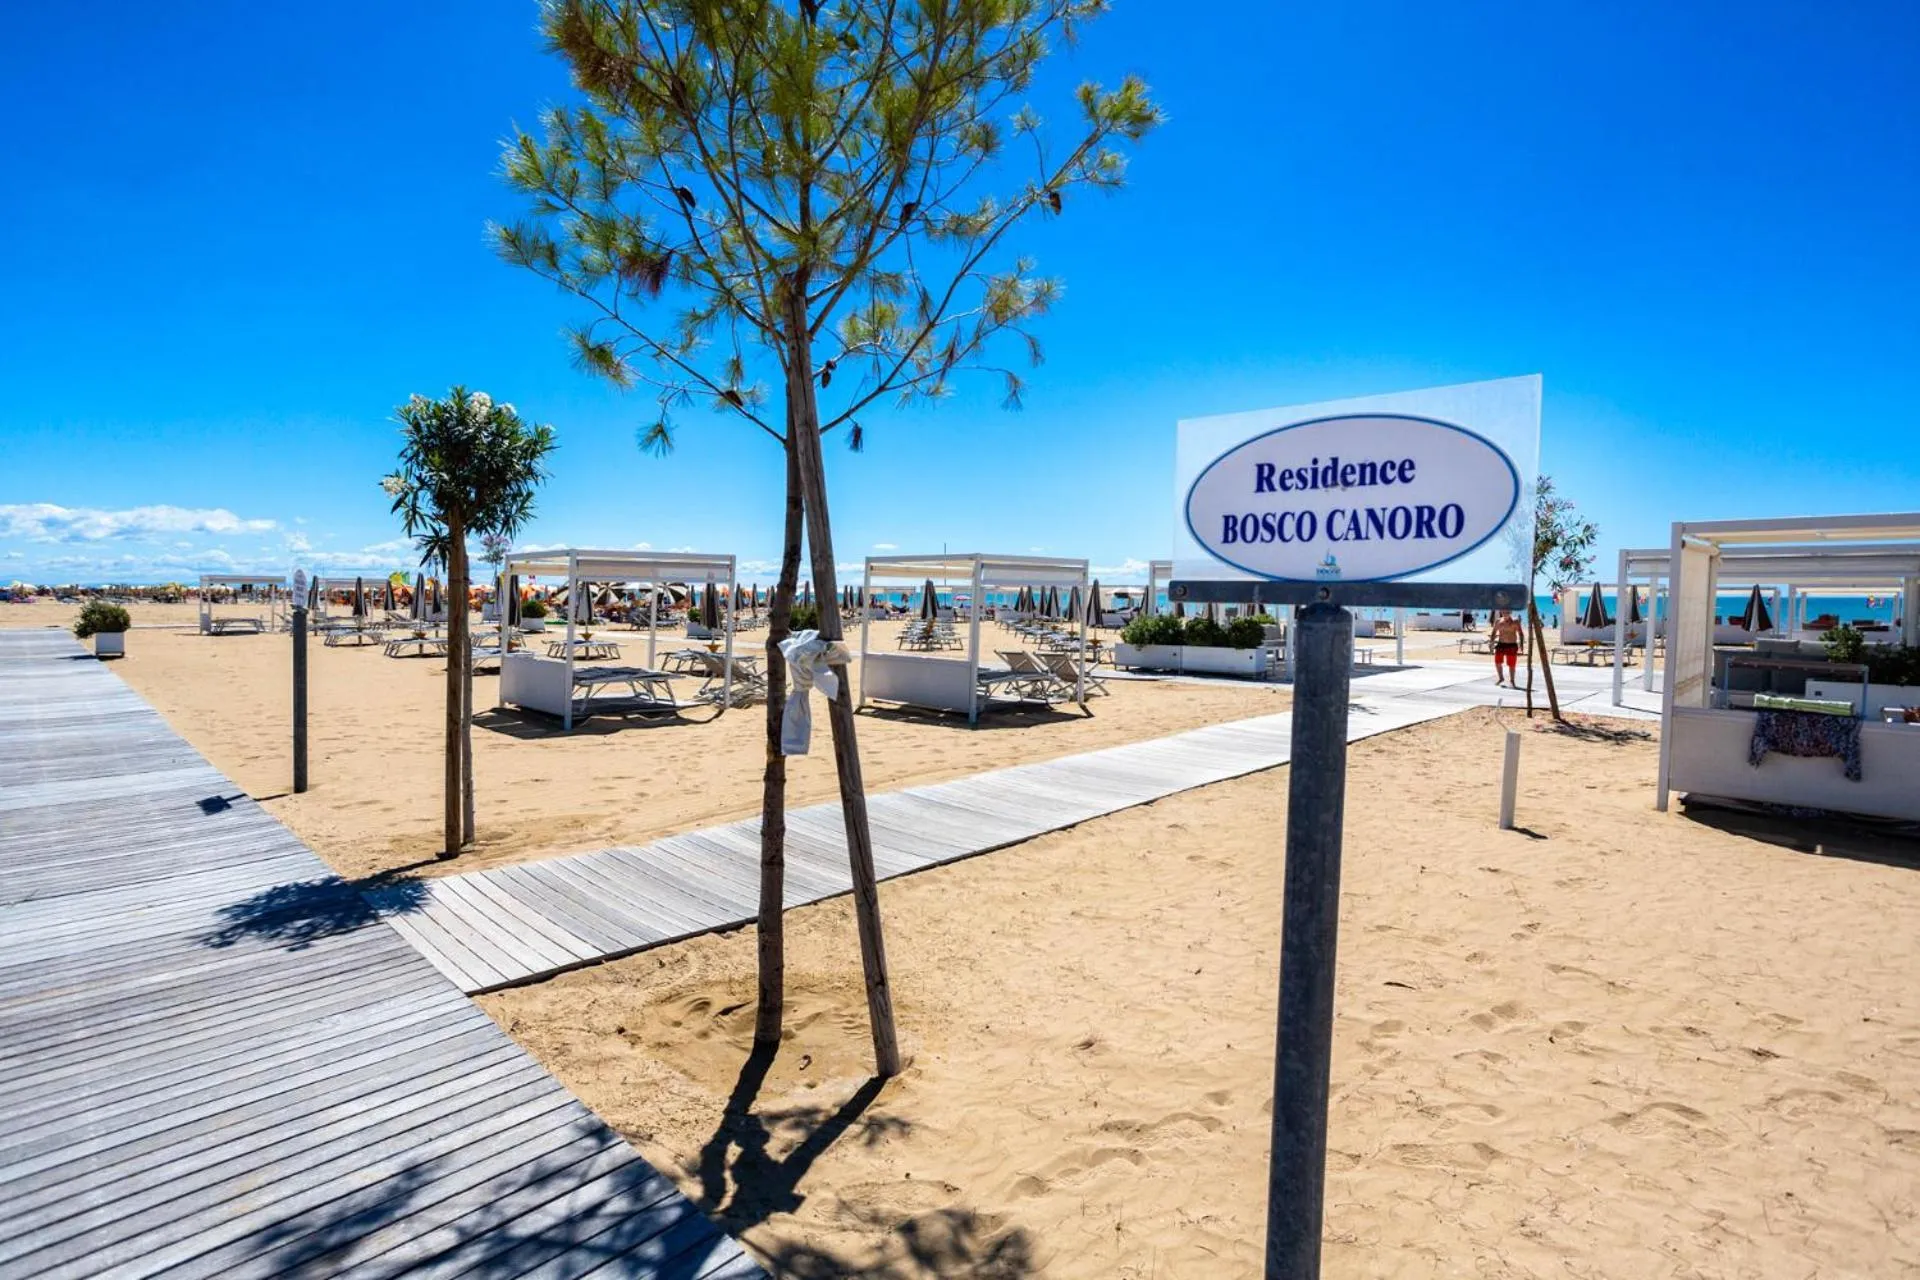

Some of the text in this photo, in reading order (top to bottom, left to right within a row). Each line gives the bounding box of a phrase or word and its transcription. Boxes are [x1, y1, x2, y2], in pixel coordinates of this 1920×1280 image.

[1255, 456, 1416, 494] Residence
[1221, 503, 1466, 544] BOSCO CANORO
